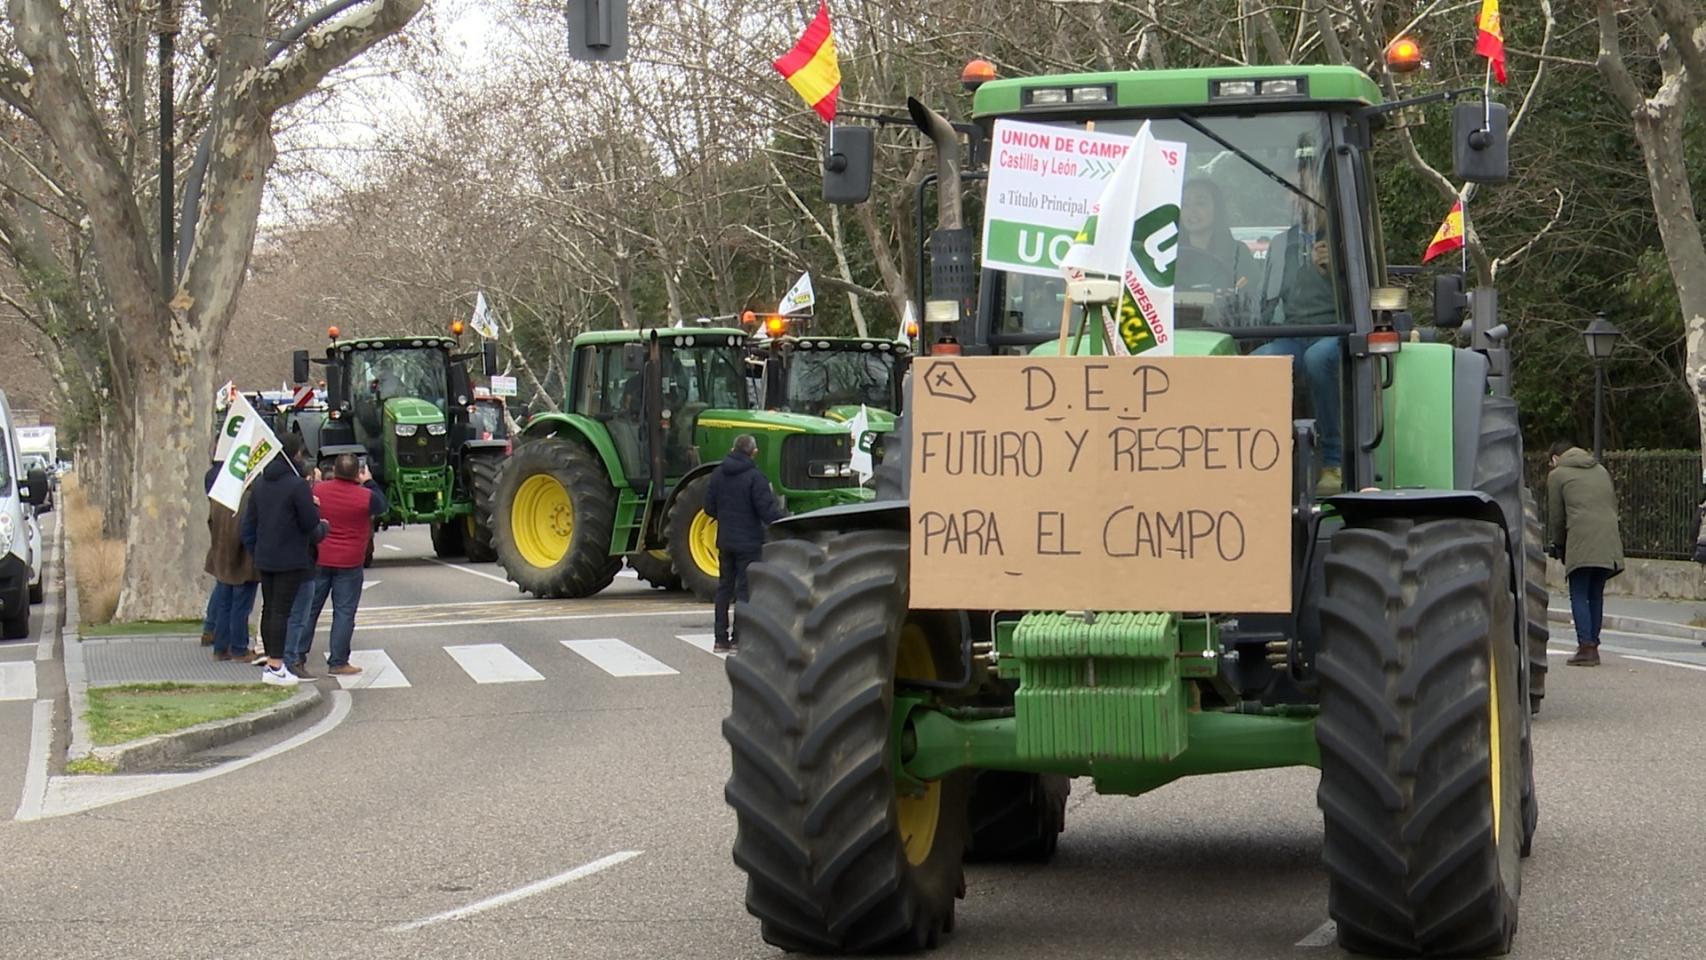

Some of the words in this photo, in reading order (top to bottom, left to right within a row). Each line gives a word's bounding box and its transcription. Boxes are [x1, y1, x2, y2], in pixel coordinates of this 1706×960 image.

[1001, 130, 1050, 150] UNION
[1055, 136, 1074, 153] DE
[999, 150, 1040, 173] Castilla
[1041, 160, 1048, 177] y
[1051, 158, 1077, 177] León
[999, 193, 1006, 204] a
[1008, 190, 1039, 208] Título
[1041, 194, 1090, 217] Principal,
[1124, 269, 1169, 345] AMPESINOS
[920, 430, 1043, 478] FUTURO
[1064, 428, 1089, 473] Y
[1108, 425, 1280, 472] RESPETO
[918, 509, 1004, 556] PARA
[1036, 511, 1082, 556] EL
[1103, 505, 1246, 562] CAMPO
